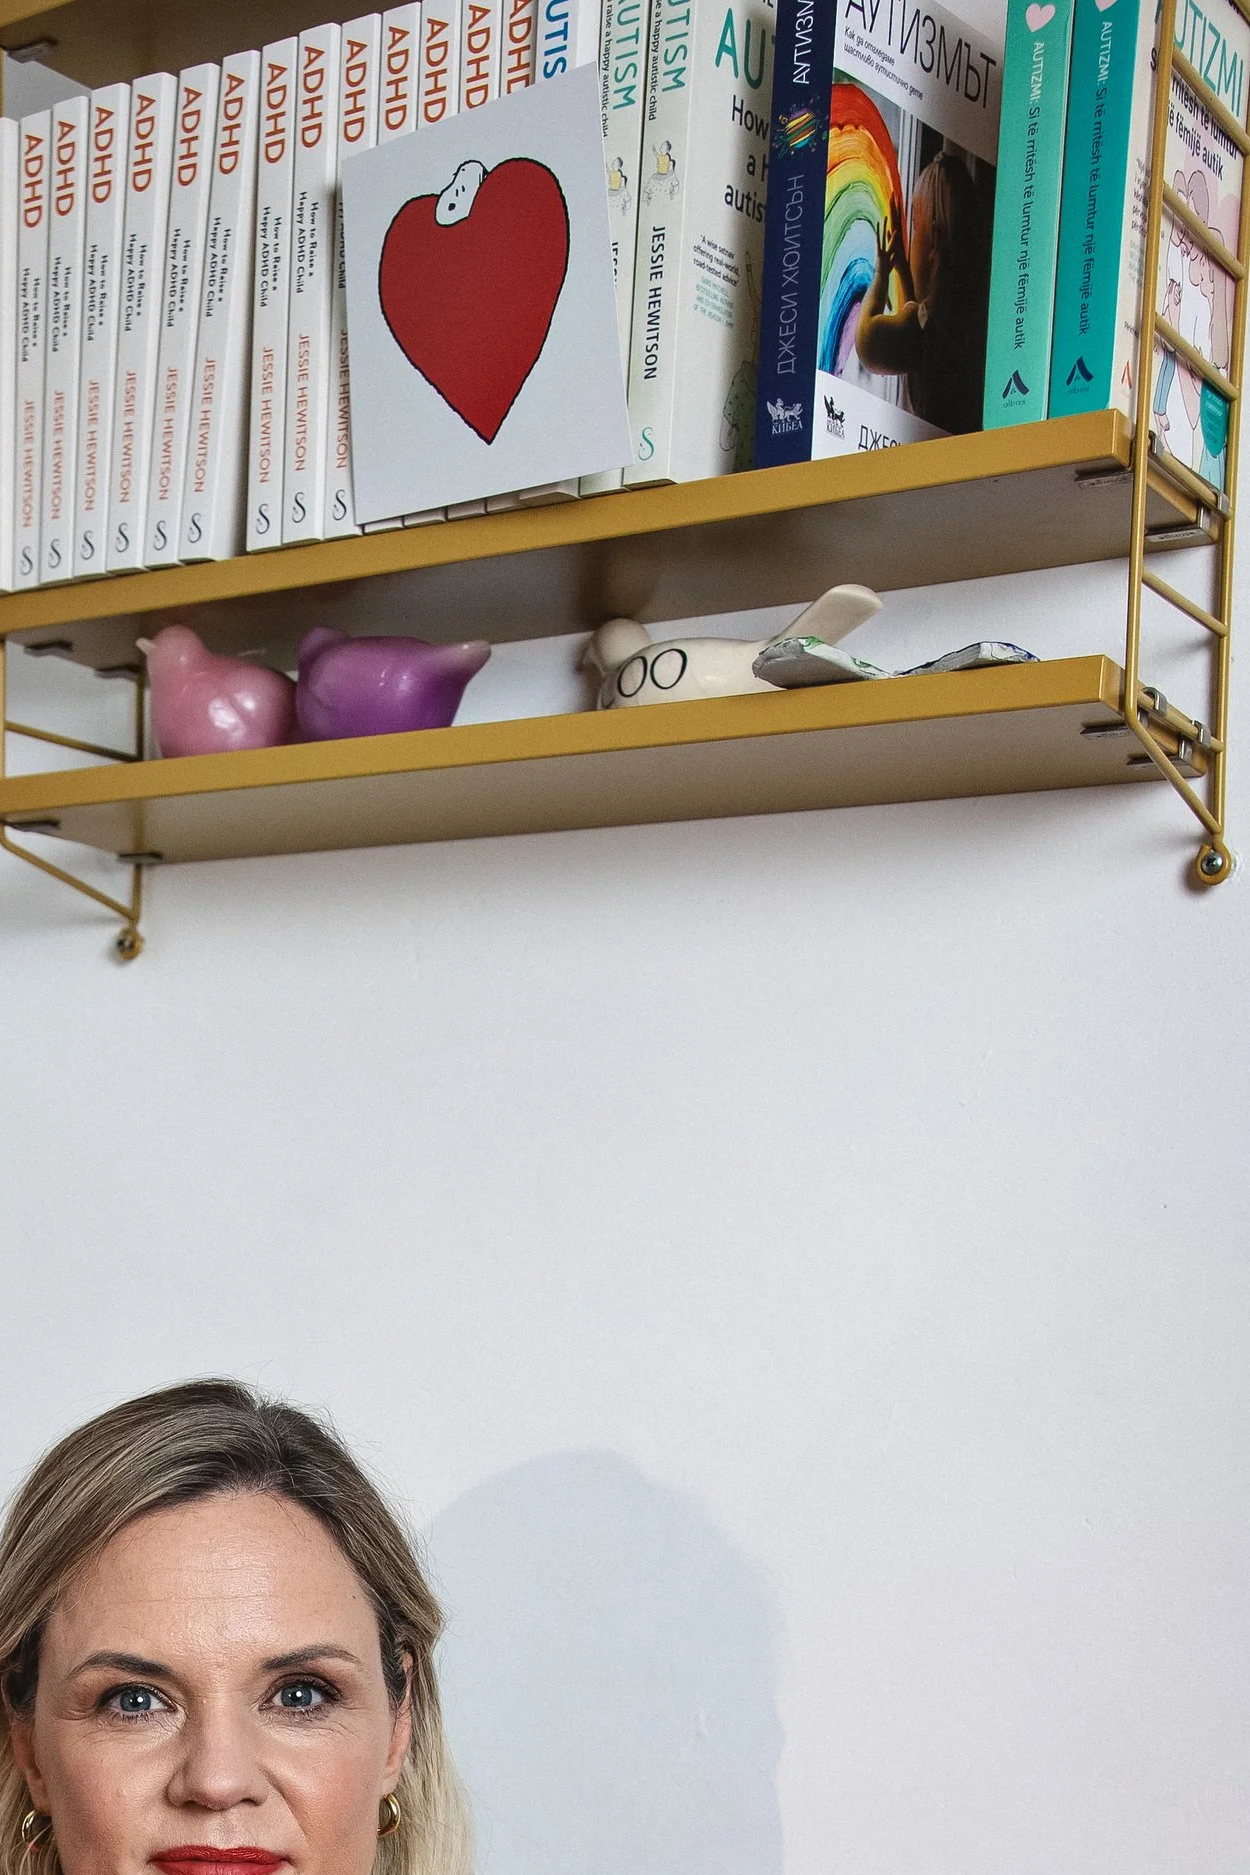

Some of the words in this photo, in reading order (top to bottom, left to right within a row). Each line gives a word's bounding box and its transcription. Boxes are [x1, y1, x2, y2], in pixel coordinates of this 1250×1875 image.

[543, 0, 568, 79] UTIS
[606, 4, 614, 28] raise
[651, 20, 662, 52] happy
[466, 4, 491, 109] ADHD
[602, 38, 612, 71] happy
[612, 0, 640, 110] UTISM
[715, 8, 769, 89] AU
[792, 0, 814, 84] АУТИЗМ
[1097, 21, 1112, 85] AUTIZMI:
[1172, 0, 1244, 118] UTIZMI
[344, 40, 368, 142] ADHD
[385, 26, 410, 130] ADHD
[424, 18, 448, 123] ADHD
[650, 56, 659, 93] autistic
[1030, 41, 1046, 104] AUTIZMI:
[1096, 88, 1107, 100] Si
[264, 63, 288, 163] ADHD
[302, 46, 325, 148] ADHD
[648, 96, 658, 121] child
[732, 94, 769, 140] How
[1028, 106, 1040, 120] Si
[1094, 102, 1106, 118] të
[132, 94, 156, 192] ADHD
[178, 87, 202, 186] ADHD
[219, 74, 244, 174] ADHD
[1028, 122, 1039, 136] të
[1091, 120, 1104, 166] rritësh
[1176, 112, 1200, 157] fëmijë
[1202, 146, 1224, 181] autik
[56, 121, 76, 216] ADHD
[93, 106, 114, 203] ADHD
[1024, 139, 1036, 183] rritësh
[1090, 168, 1101, 182] të
[24, 134, 43, 228] ADHD
[724, 184, 766, 222] autis
[1023, 186, 1035, 199] të
[260, 206, 270, 238] Happy
[296, 192, 307, 224] Happy
[782, 174, 804, 288] ХЮИТСЪН
[1016, 201, 1034, 246] lumtur
[1086, 184, 1100, 231] lumtur
[261, 243, 269, 277] ADHD
[298, 228, 306, 262] ADHD
[650, 226, 665, 282] JESSIE
[1017, 248, 1030, 270] një
[1082, 234, 1094, 252] një
[260, 280, 268, 307] Child
[296, 266, 304, 293] Child
[1014, 272, 1030, 314] fëmijë
[1080, 258, 1094, 300] fëmijë
[644, 286, 662, 380] HEWITSON
[778, 292, 797, 374] ДЖЕСИ
[1014, 317, 1026, 350] autik
[1079, 302, 1090, 336] autik
[202, 357, 216, 405] JESSIE
[262, 346, 274, 394] JESSIE
[298, 334, 310, 382] JESSIE
[53, 390, 64, 435] JESSIE
[88, 379, 99, 426] JESSIE
[124, 370, 136, 416] JESSIE
[165, 366, 178, 414] JESSIE
[24, 400, 34, 445] JESSIE
[259, 400, 272, 484] HEWITSON
[294, 386, 308, 471] HEWITSON
[85, 430, 97, 512] HEWITSON
[119, 421, 133, 503] HEWITSON
[158, 418, 174, 500] HEWITSON
[194, 410, 211, 492] HEWITSON
[22, 449, 34, 528] HEWITSON
[51, 440, 63, 520] HEWITSON
